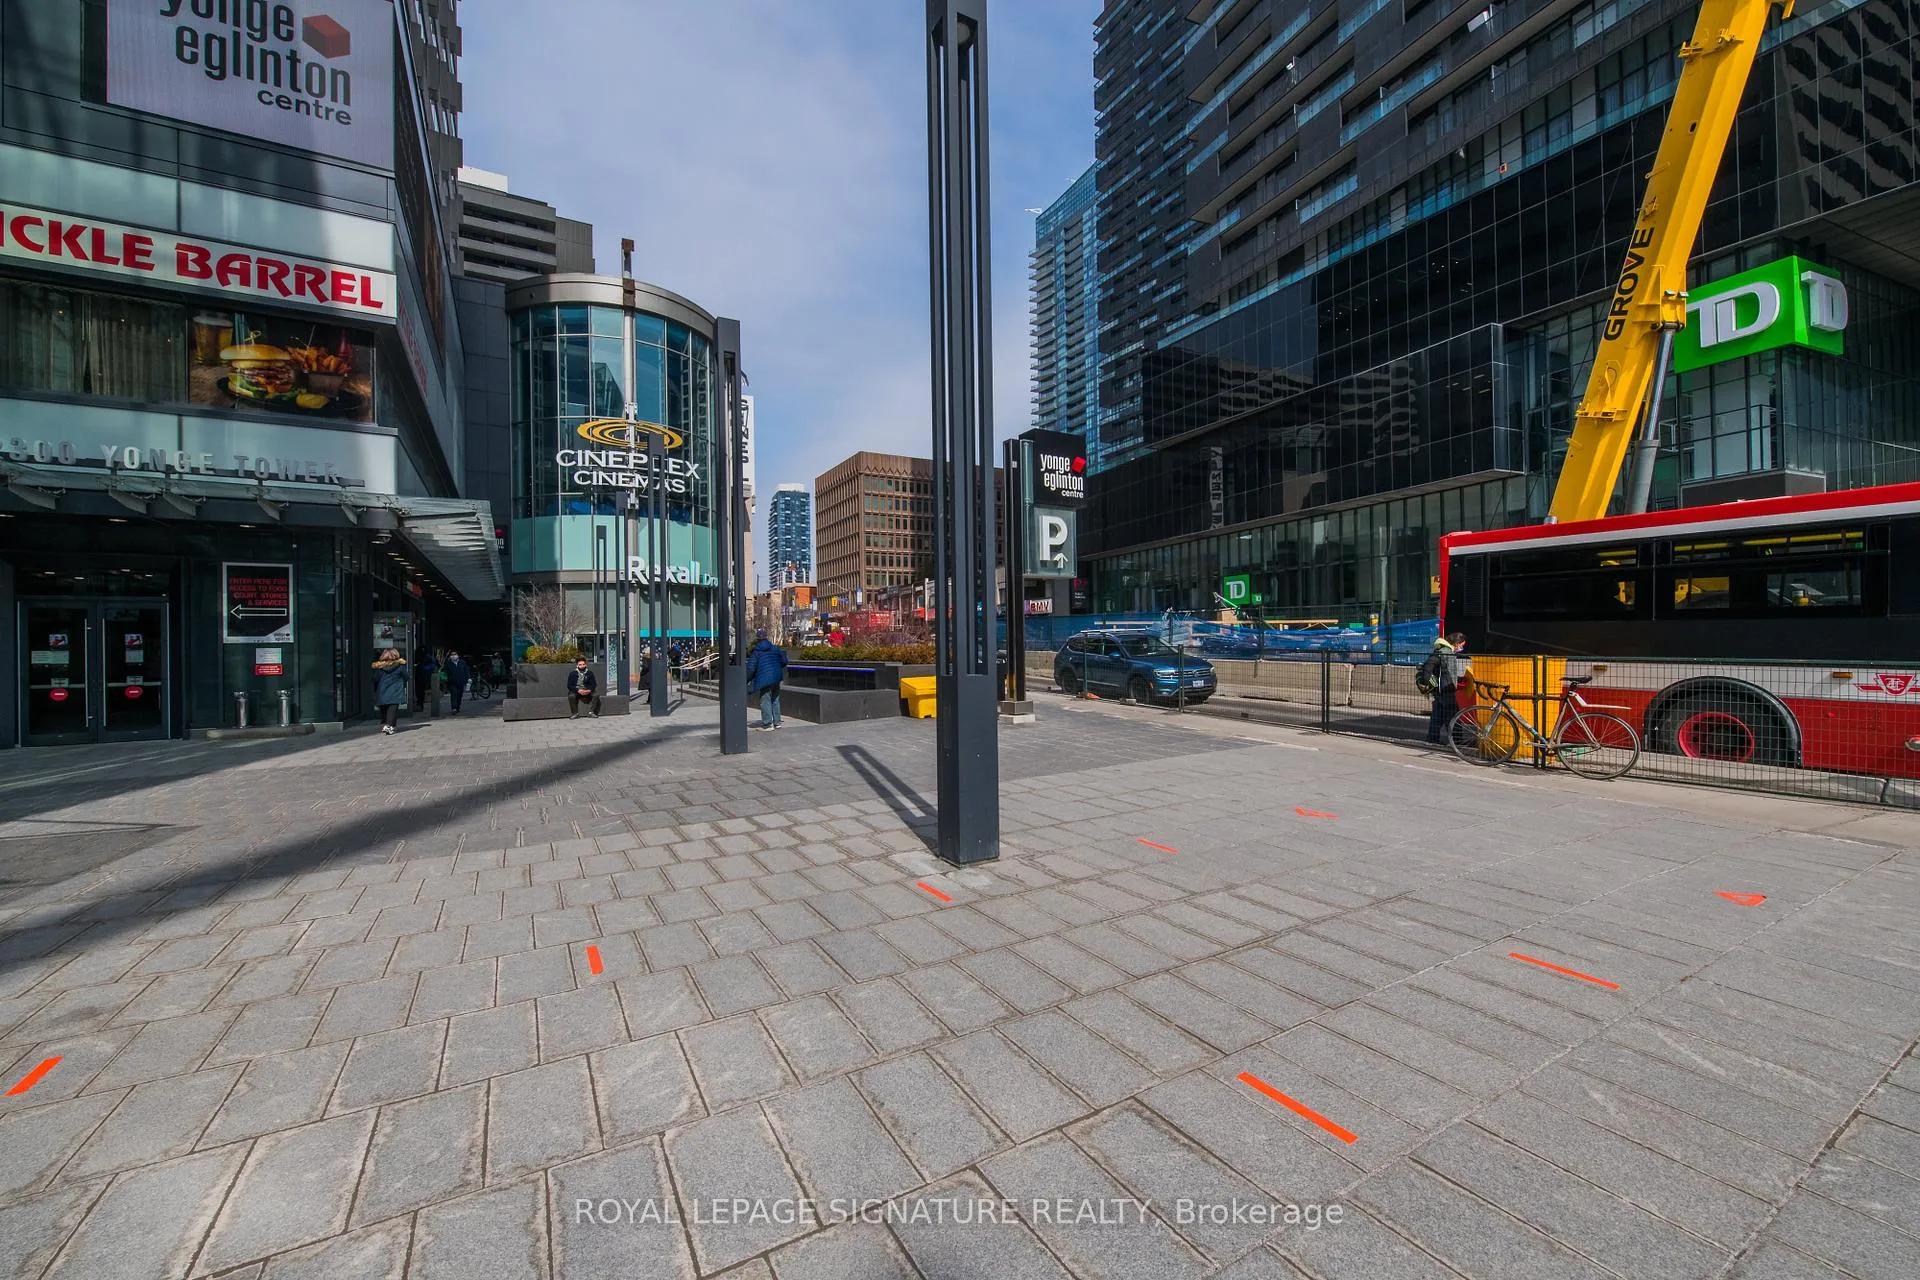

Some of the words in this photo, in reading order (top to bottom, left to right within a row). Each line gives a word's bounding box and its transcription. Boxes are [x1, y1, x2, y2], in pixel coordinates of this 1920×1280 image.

[175, 25, 351, 107] eglinton
[257, 89, 352, 126] centre
[175, 242, 384, 309] BARREL
[1603, 227, 1655, 341] GROVE
[1686, 281, 1781, 348] TD
[1801, 270, 1848, 332] TD
[0, 437, 76, 465] 300
[101, 444, 215, 475] YONGE
[233, 454, 341, 484] TOWER
[1040, 453, 1071, 474] yonge
[573, 470, 686, 493] CINEMAS
[1044, 471, 1084, 492] eglinton
[1061, 489, 1084, 499] centre
[1040, 515, 1068, 561] P
[628, 555, 700, 585] Rexall
[1226, 580, 1246, 600] TD
